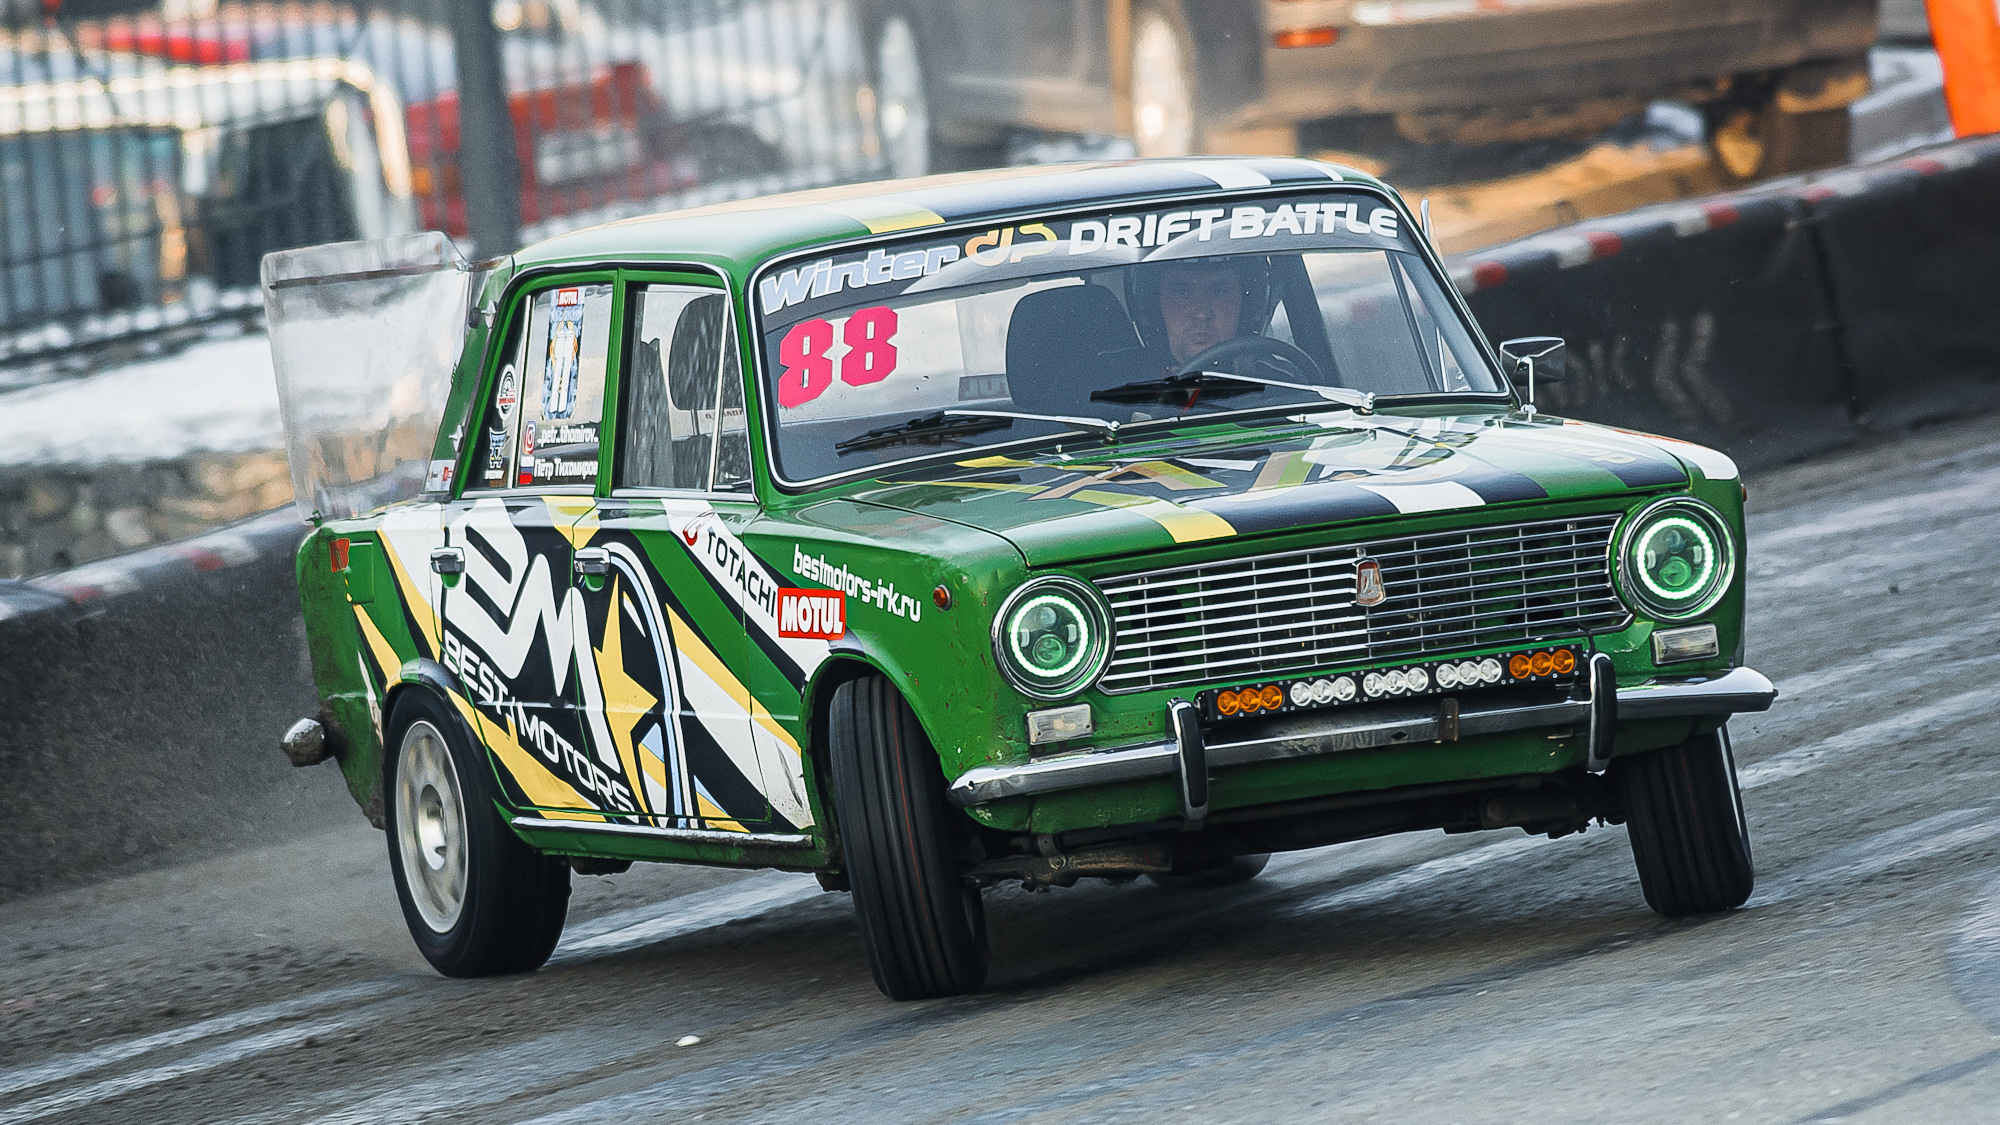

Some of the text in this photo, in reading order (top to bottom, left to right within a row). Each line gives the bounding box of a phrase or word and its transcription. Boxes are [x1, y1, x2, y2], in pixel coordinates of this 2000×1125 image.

[760, 245, 961, 315] Winter
[1069, 208, 1224, 255] DRIFT
[1230, 203, 1399, 239] BATTLE
[778, 305, 898, 409] 88
[533, 457, 599, 481] Пётр Тихомиров
[707, 526, 777, 618] TOTACHI
[780, 595, 844, 635] MOTUL
[793, 543, 922, 622] bestmotors-irk.ru
[444, 629, 640, 824] BEST MOTORS
